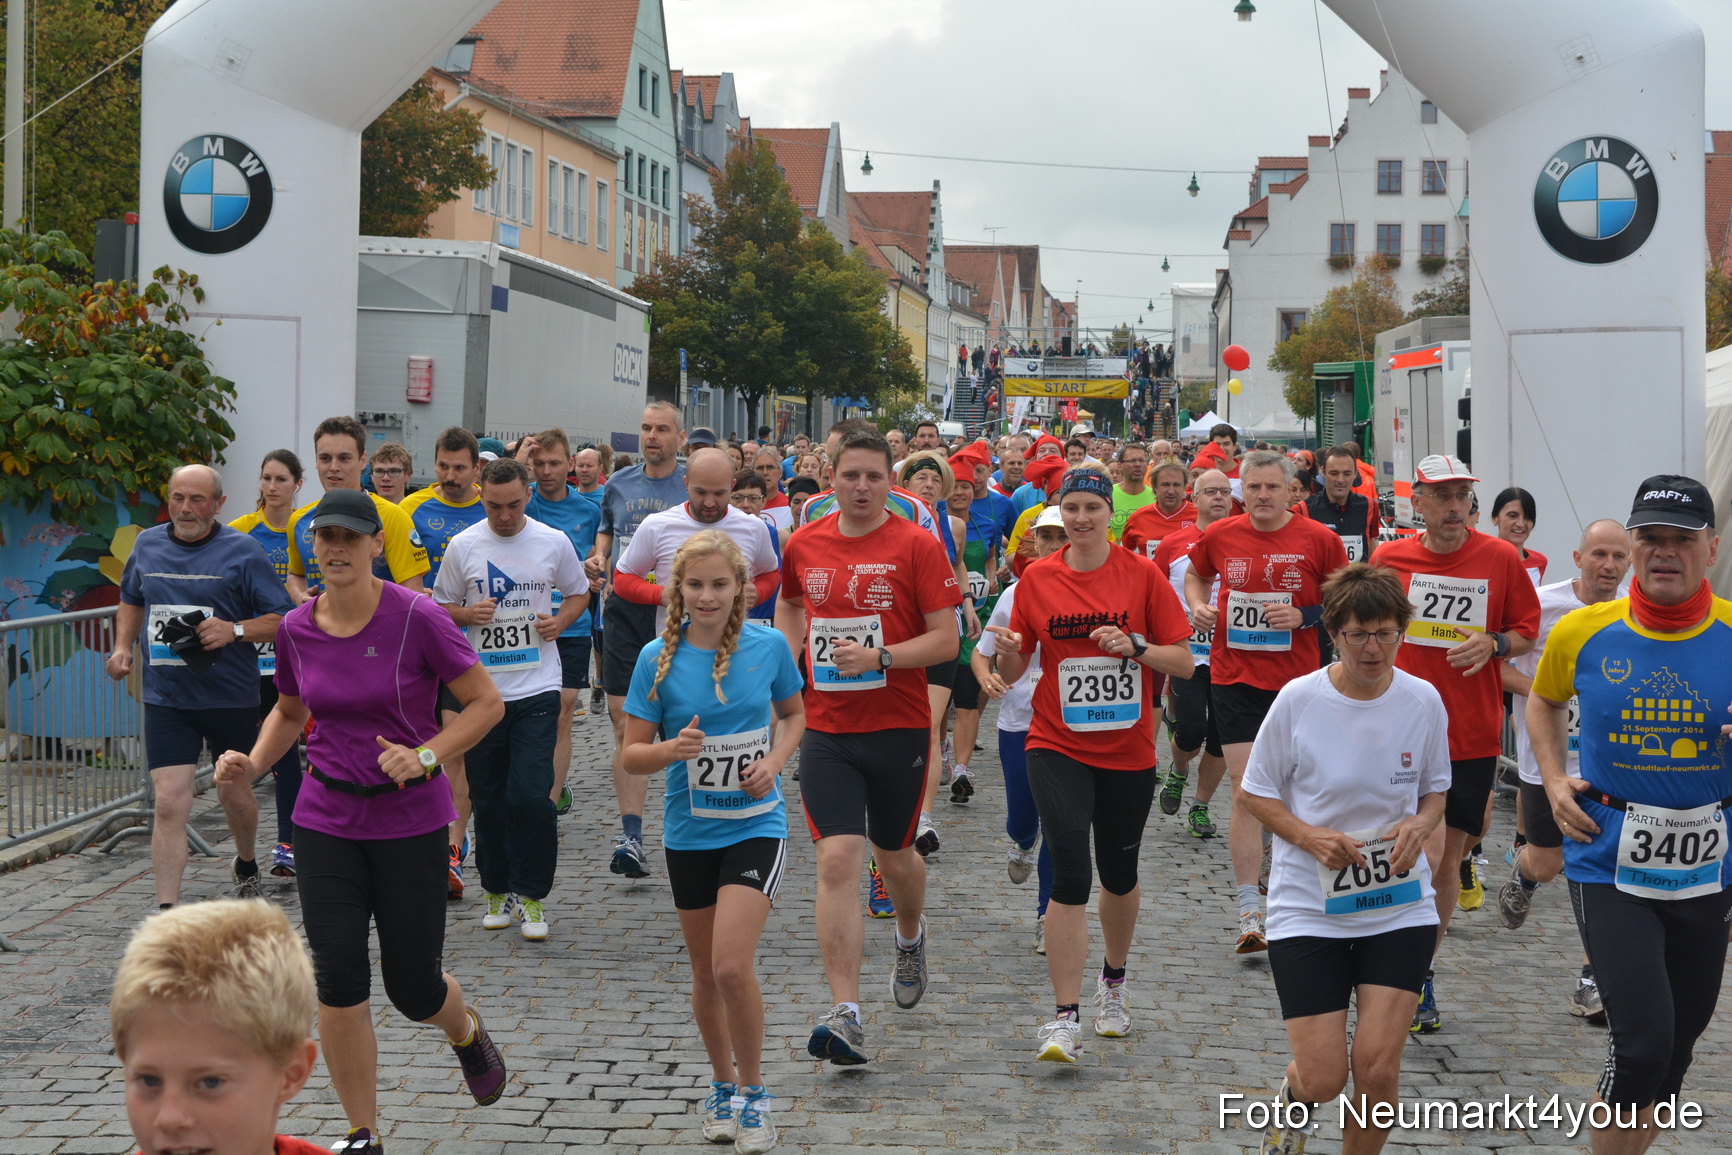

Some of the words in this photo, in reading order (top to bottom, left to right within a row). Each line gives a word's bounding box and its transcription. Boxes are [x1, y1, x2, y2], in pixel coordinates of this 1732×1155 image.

[171, 137, 264, 178] BMW
[1544, 139, 1650, 182] BMW
[613, 343, 643, 386] BOCK
[1044, 382, 1087, 393] START
[1643, 490, 1682, 501] CRAFT
[1347, 546, 1355, 561] 6
[807, 585, 826, 593] NEU
[1411, 580, 1436, 589] PARTL
[1438, 583, 1475, 593] Neumarkt
[499, 598, 530, 608] Team
[1422, 592, 1472, 622] 272
[495, 615, 526, 623] Neumarkt
[1233, 606, 1270, 628] 204
[831, 625, 867, 633] Neumarkt
[1053, 626, 1070, 637] RUN
[1072, 624, 1088, 636] FOR
[1432, 626, 1457, 638] Hans
[481, 623, 531, 650] 2831
[1248, 633, 1267, 643] Fritz
[489, 653, 527, 664] Christian
[1067, 674, 1134, 703] 2393
[1087, 709, 1115, 720] Petra
[1622, 725, 1681, 734] 21.September
[1684, 726, 1704, 734] 2014
[700, 744, 719, 752] RTL
[721, 738, 760, 752] Neumarkt
[1612, 761, 1720, 772] www.stadtlauf-neumarkt.de
[1627, 812, 1662, 827] PARTL
[1665, 816, 1712, 828] Neumarkt
[1630, 828, 1720, 865] 3402
[1626, 869, 1699, 888] Thomas
[1356, 893, 1393, 909] Maria
